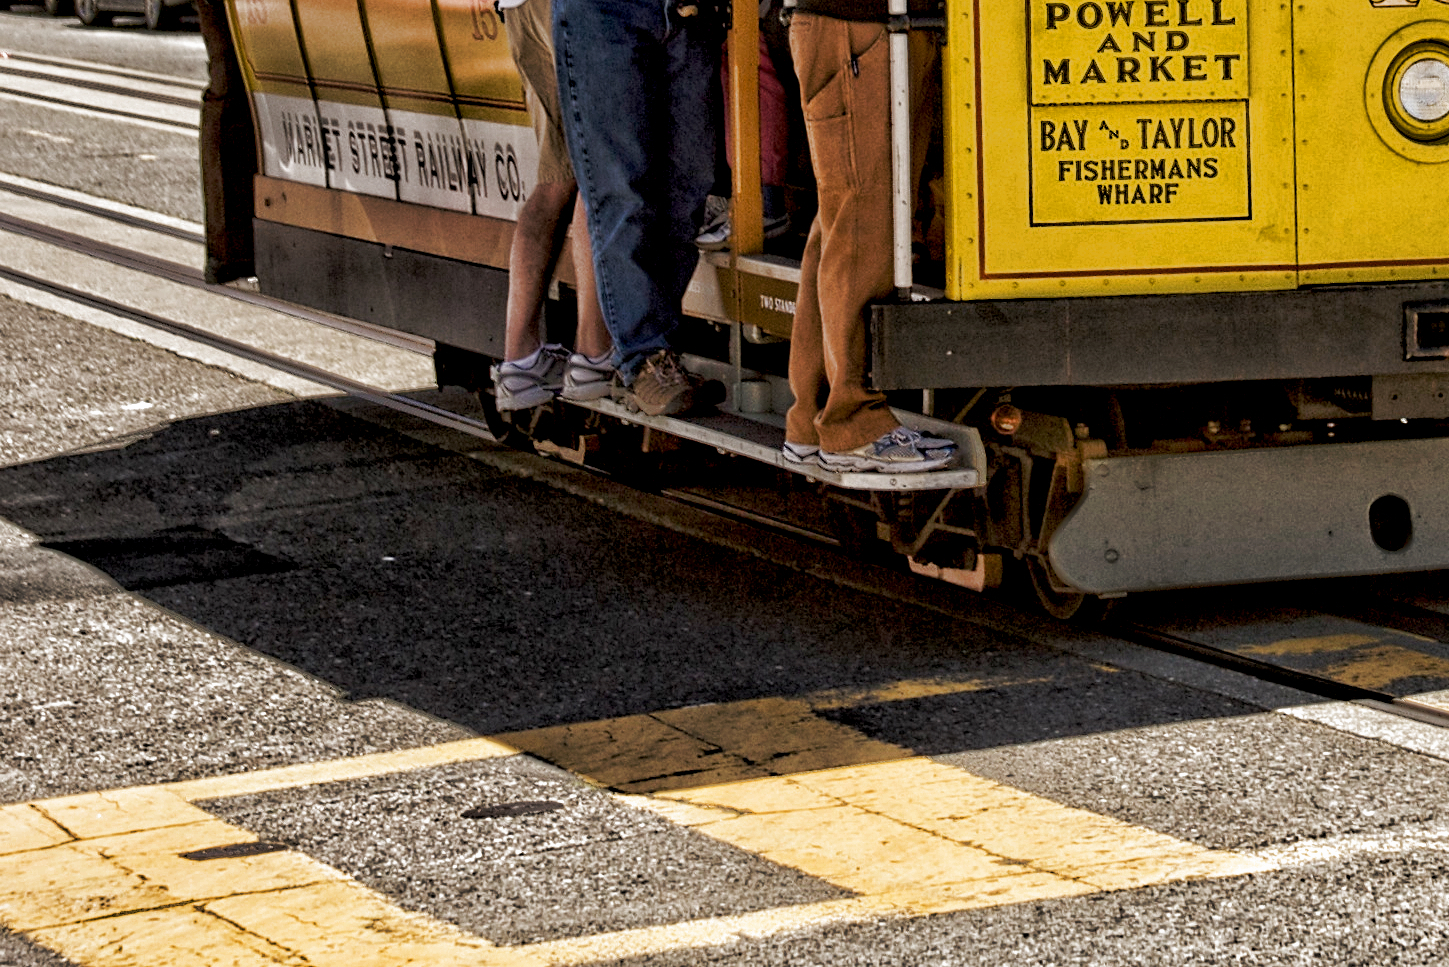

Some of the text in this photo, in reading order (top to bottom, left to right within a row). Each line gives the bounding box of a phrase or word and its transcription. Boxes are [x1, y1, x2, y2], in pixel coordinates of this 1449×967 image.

[1097, 31, 1190, 53] AND
[1042, 54, 1241, 85] MARKET
[1040, 117, 1236, 152] BAY AND TAYLOR
[1058, 157, 1219, 182] FISHERMANS
[1097, 183, 1179, 205] WHARF
